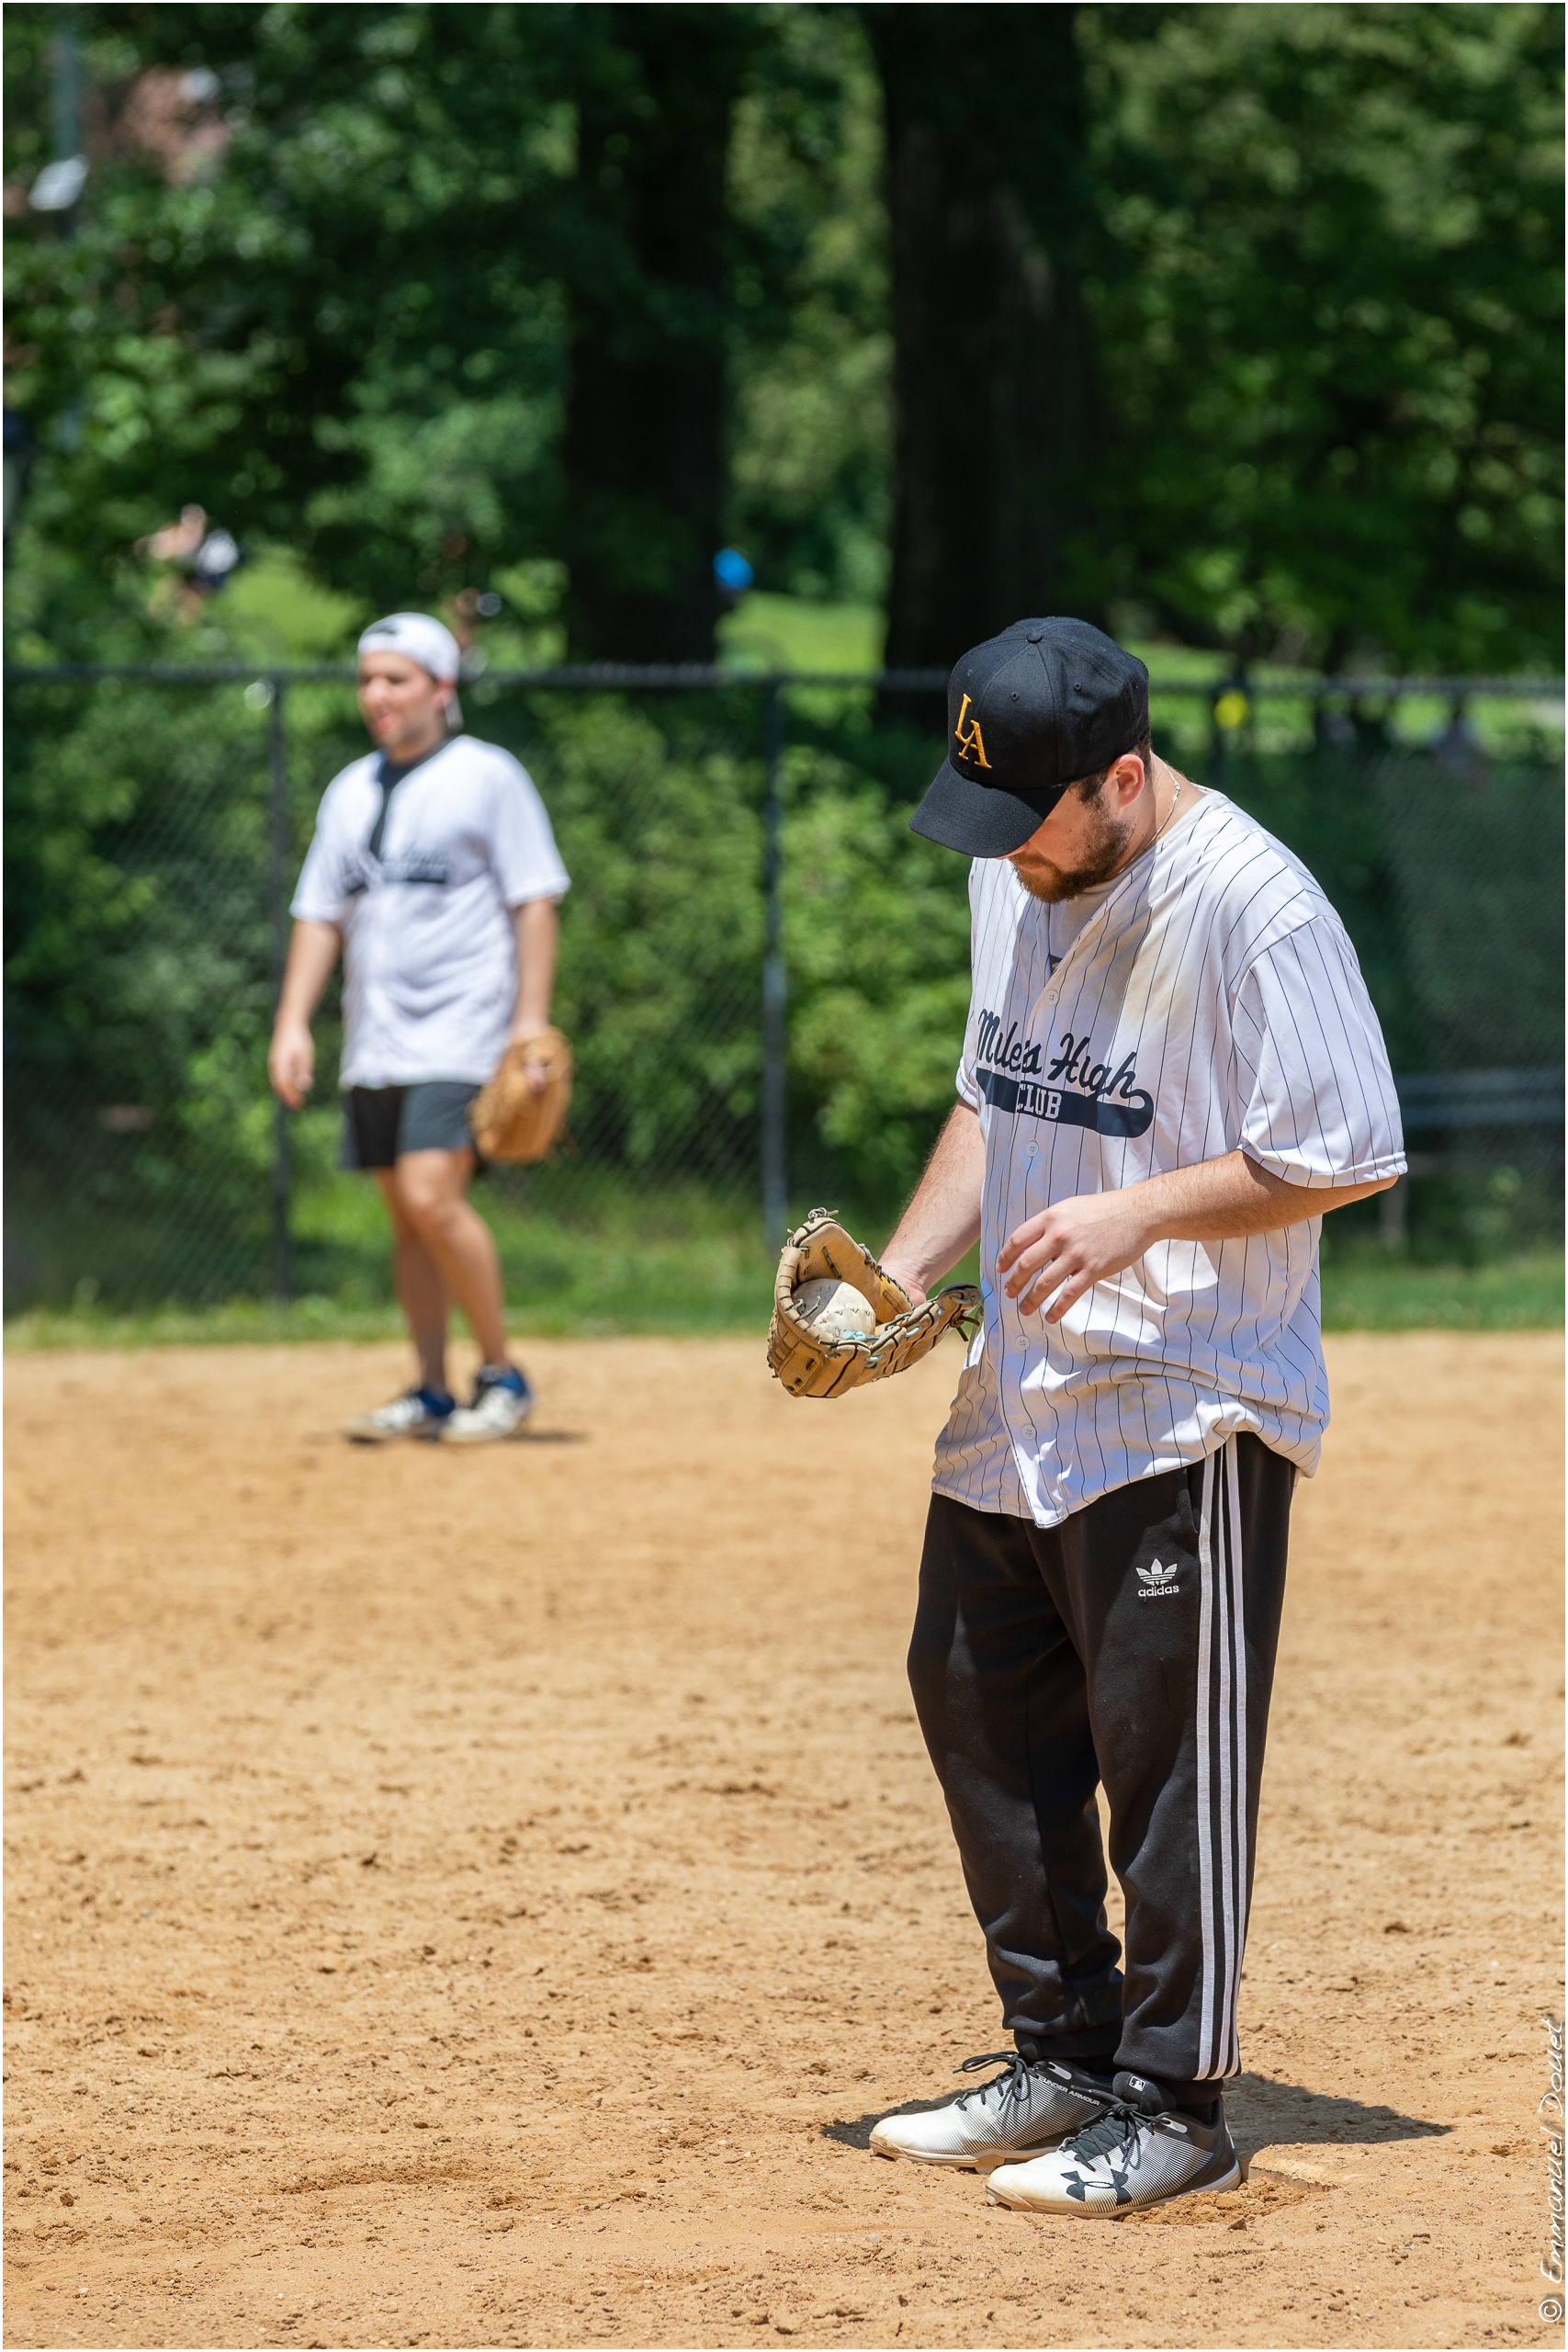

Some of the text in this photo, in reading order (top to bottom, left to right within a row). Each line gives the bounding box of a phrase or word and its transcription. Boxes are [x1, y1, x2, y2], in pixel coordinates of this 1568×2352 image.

[954, 693, 992, 768] LA
[1047, 1032, 1137, 1100] High
[1137, 1585, 1179, 1597] adidas
[1043, 2077, 1100, 2106] UNDER ARMOUR
